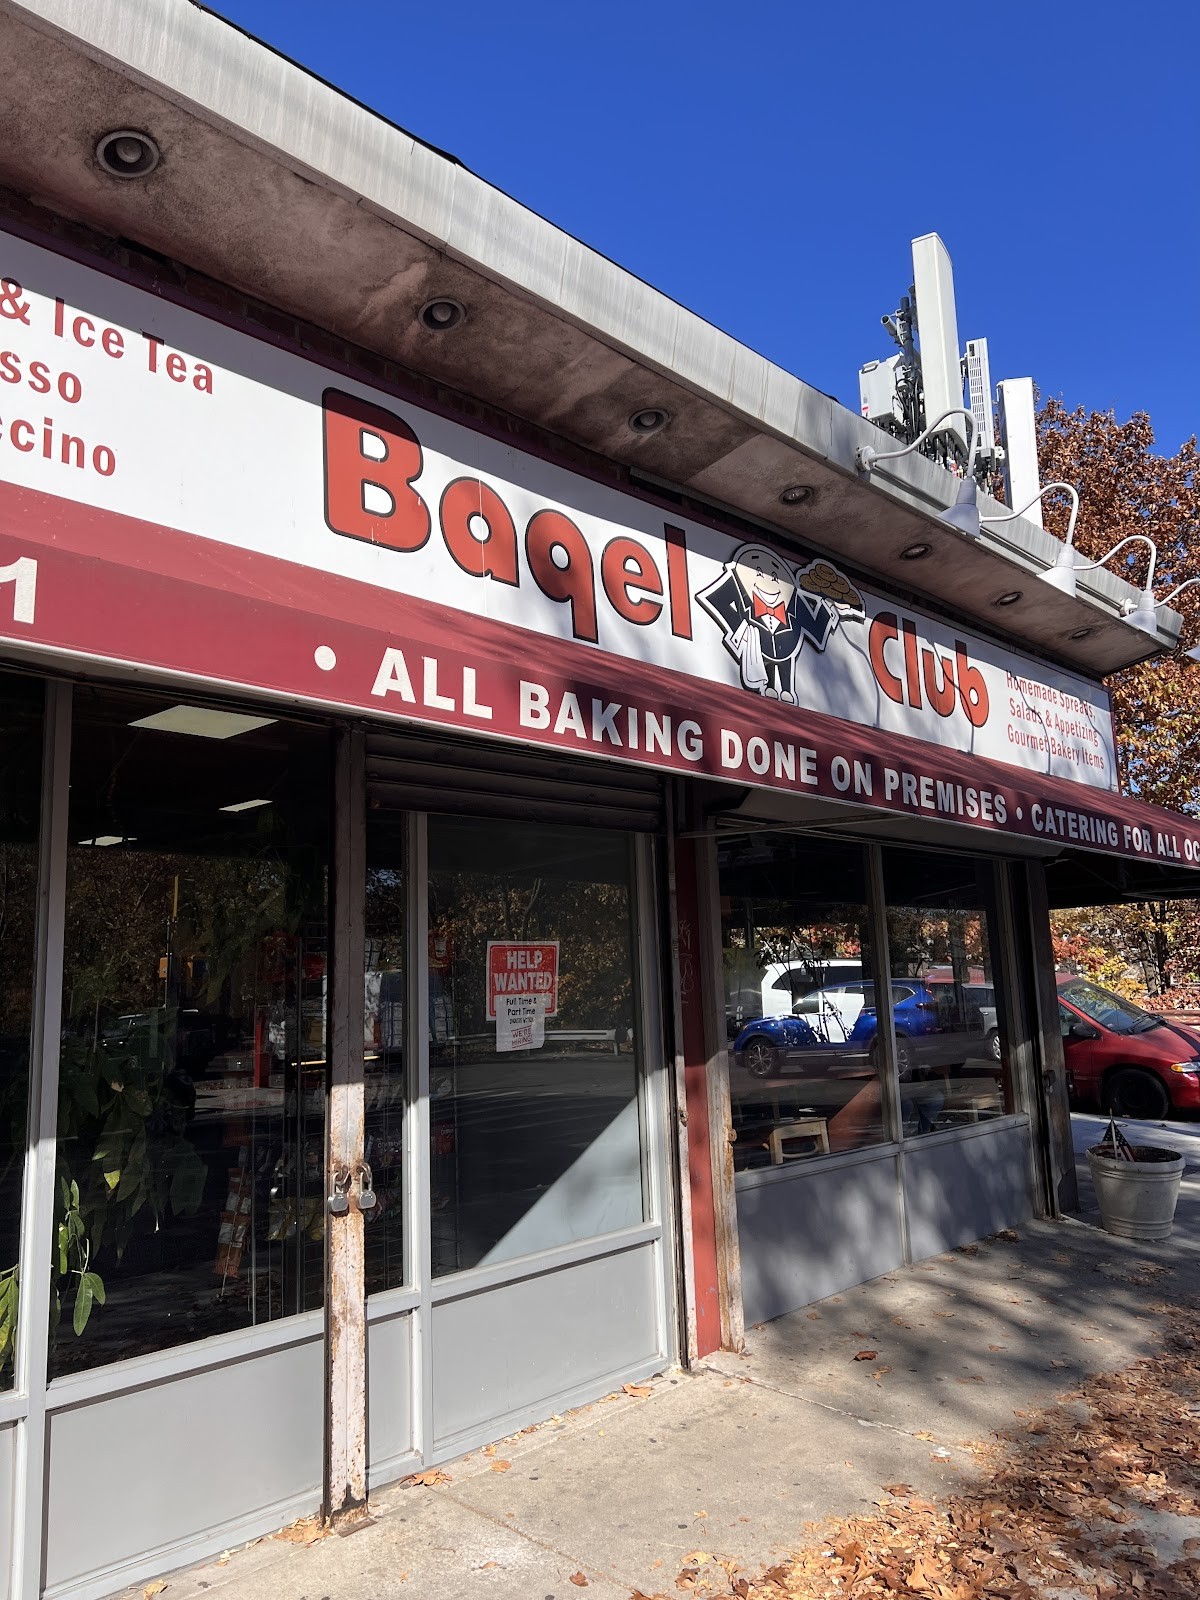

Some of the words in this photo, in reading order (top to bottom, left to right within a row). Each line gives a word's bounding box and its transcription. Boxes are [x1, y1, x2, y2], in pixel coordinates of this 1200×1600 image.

[0, 277, 30, 326] &
[54, 296, 125, 359] Ice
[142, 331, 213, 394] Tea
[0, 351, 82, 404] sso
[0, 416, 116, 477] cino
[0, 556, 37, 624] 1
[869, 611, 989, 728] Club
[1006, 669, 1058, 705] Homemade
[1007, 724, 1050, 753] Gourmet
[1051, 737, 1080, 766] Bakery
[1081, 747, 1104, 769] Items
[1009, 697, 1043, 725] Salads
[1045, 709, 1053, 728] &
[1055, 713, 1099, 747] Appetizing
[370, 646, 493, 720] ALL
[519, 679, 704, 762] BAKING
[720, 728, 818, 785] DONE
[830, 755, 873, 797] ON
[884, 768, 1007, 824] PREMISES
[1031, 803, 1118, 847] CATERING
[1123, 825, 1153, 854] FOR
[1157, 832, 1181, 859] ALL
[493, 972, 552, 992] WANTED
[507, 950, 543, 969] HELP
[507, 1008, 521, 1016] Part
